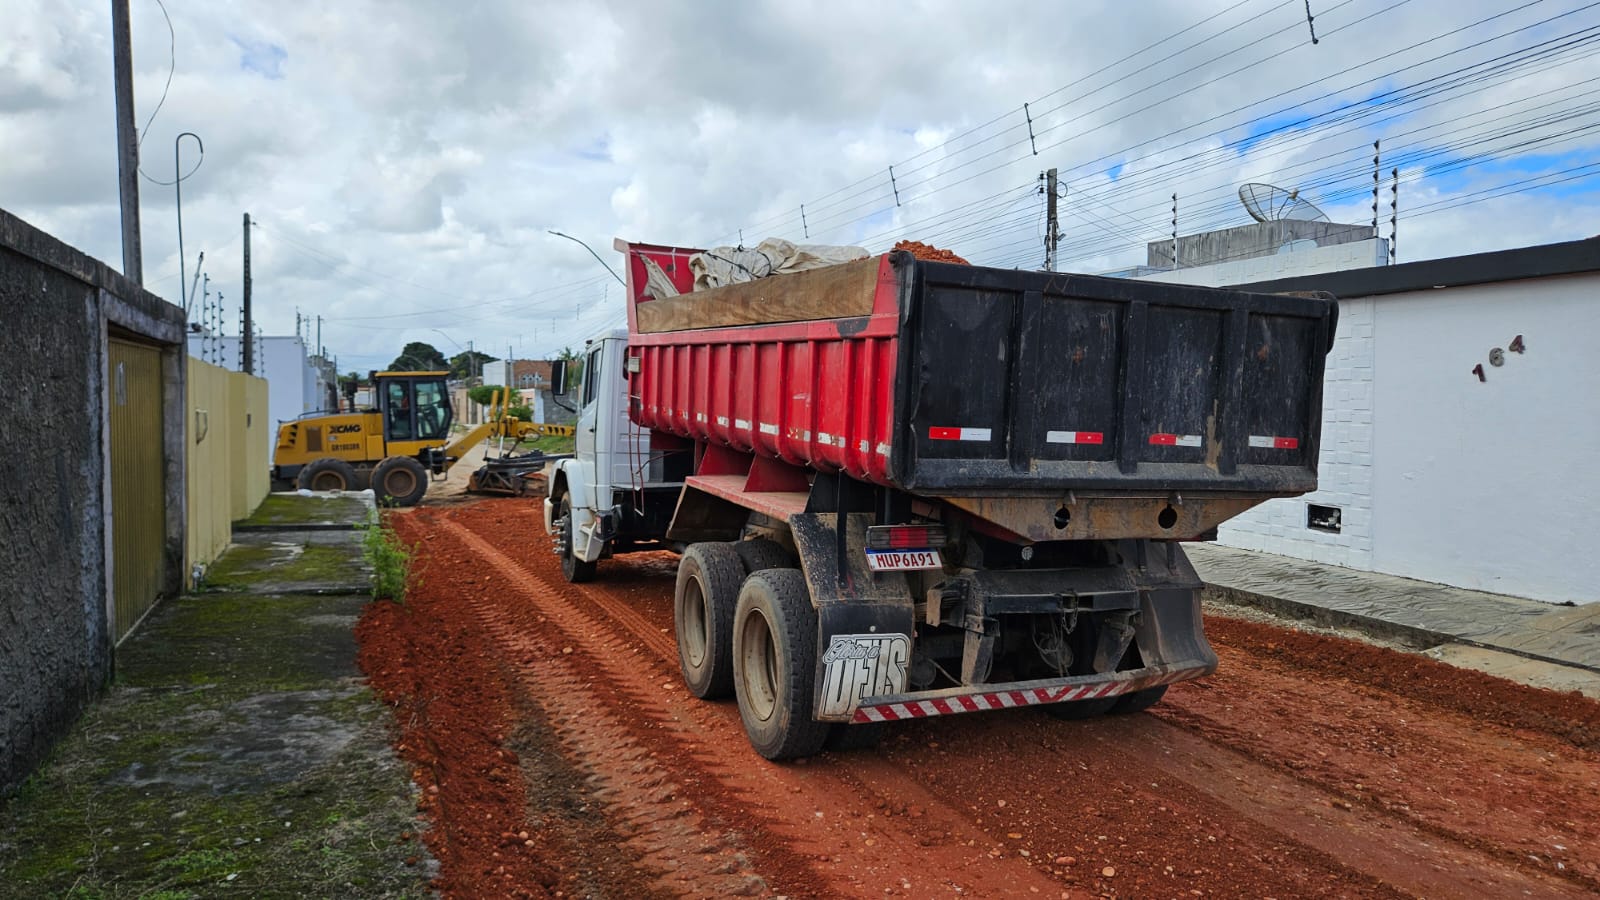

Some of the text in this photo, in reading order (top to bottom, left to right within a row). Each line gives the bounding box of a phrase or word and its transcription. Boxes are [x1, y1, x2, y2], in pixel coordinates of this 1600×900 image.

[1472, 334, 1526, 382] 164
[329, 424, 361, 434] XCMG
[876, 552, 935, 568] MUP6A91
[823, 638, 908, 716] DEUS
